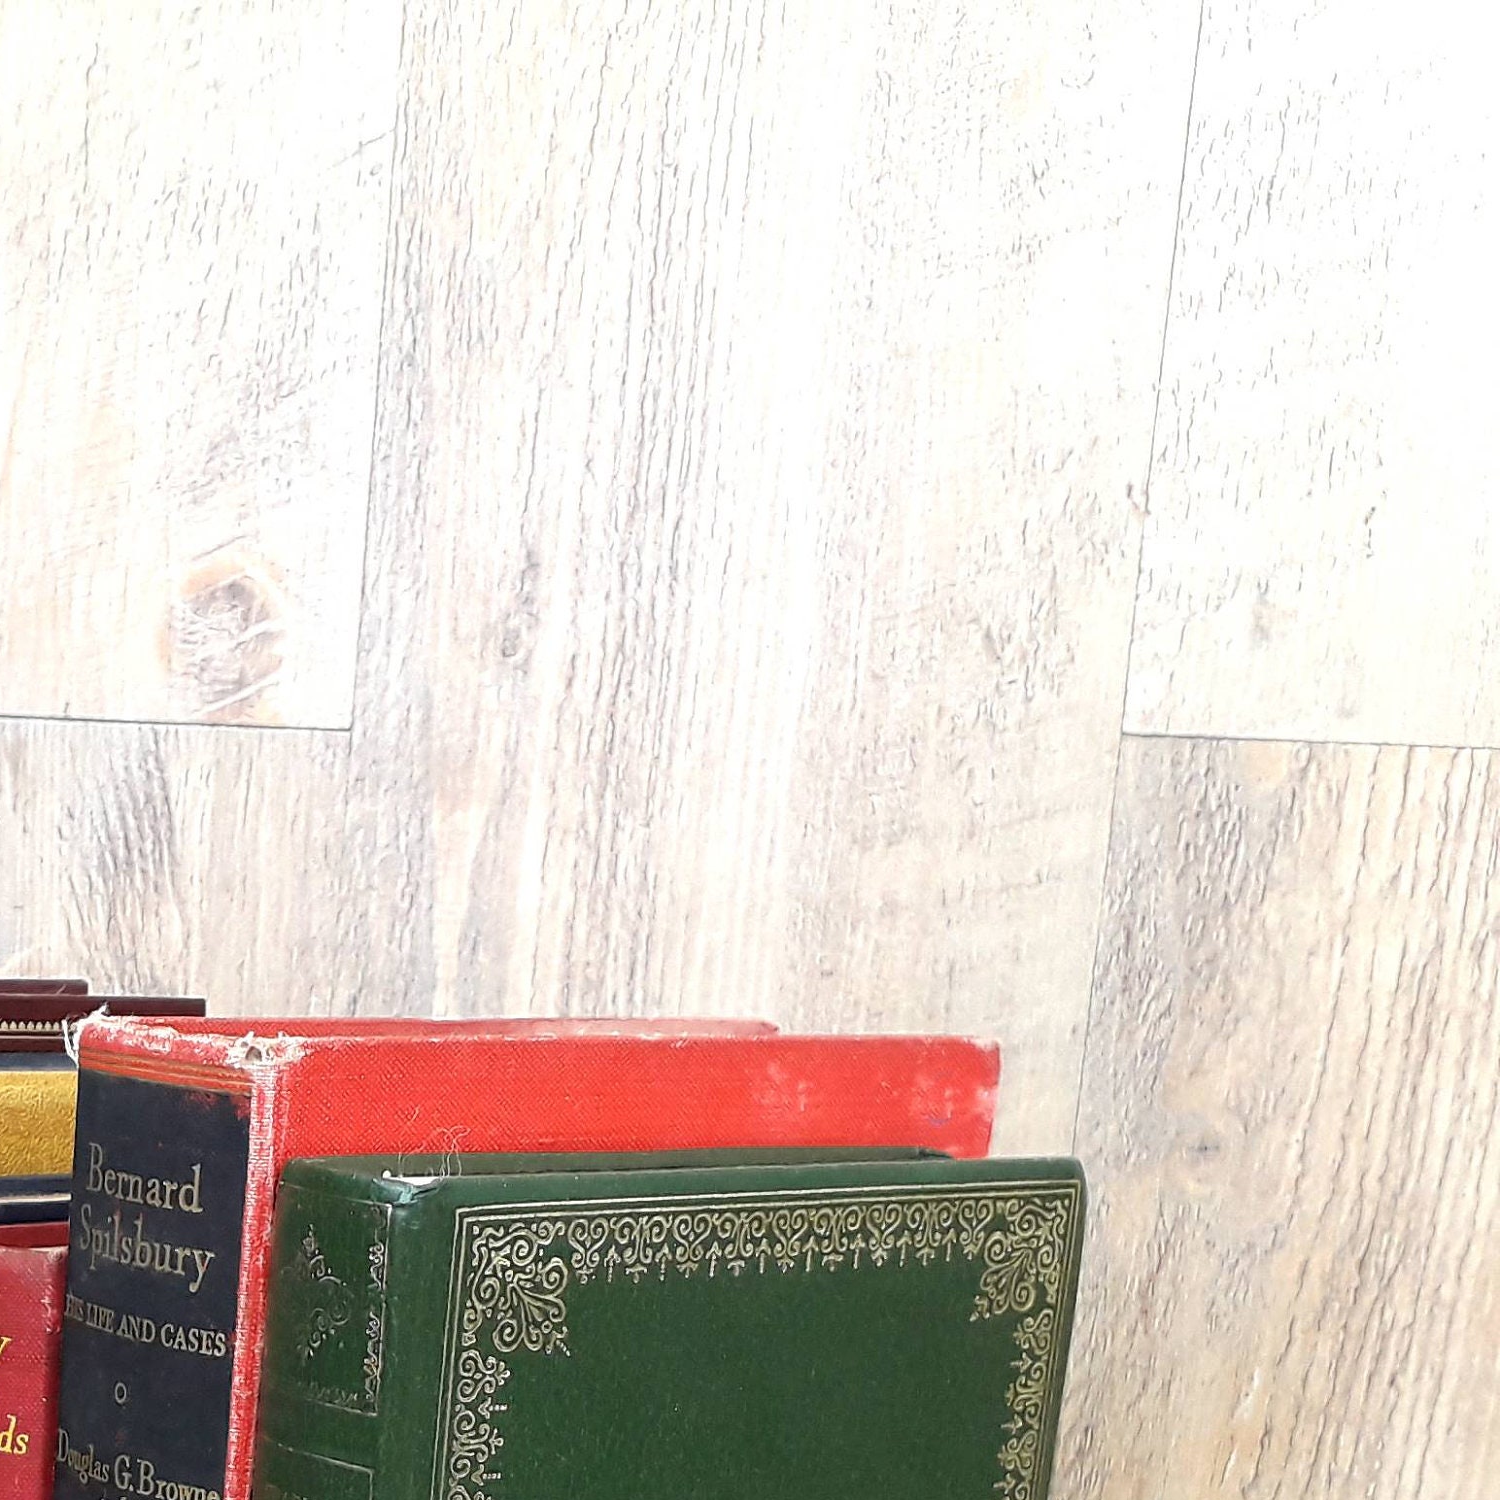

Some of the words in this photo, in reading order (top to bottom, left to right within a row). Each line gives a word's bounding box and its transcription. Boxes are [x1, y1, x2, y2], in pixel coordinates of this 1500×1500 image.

[86, 1142, 203, 1213] Bernard
[80, 1204, 215, 1293] Spilsbury
[86, 1303, 114, 1333] LIFE
[117, 1314, 156, 1343] AND
[161, 1323, 227, 1357] CASES
[57, 1428, 110, 1485] Douglas
